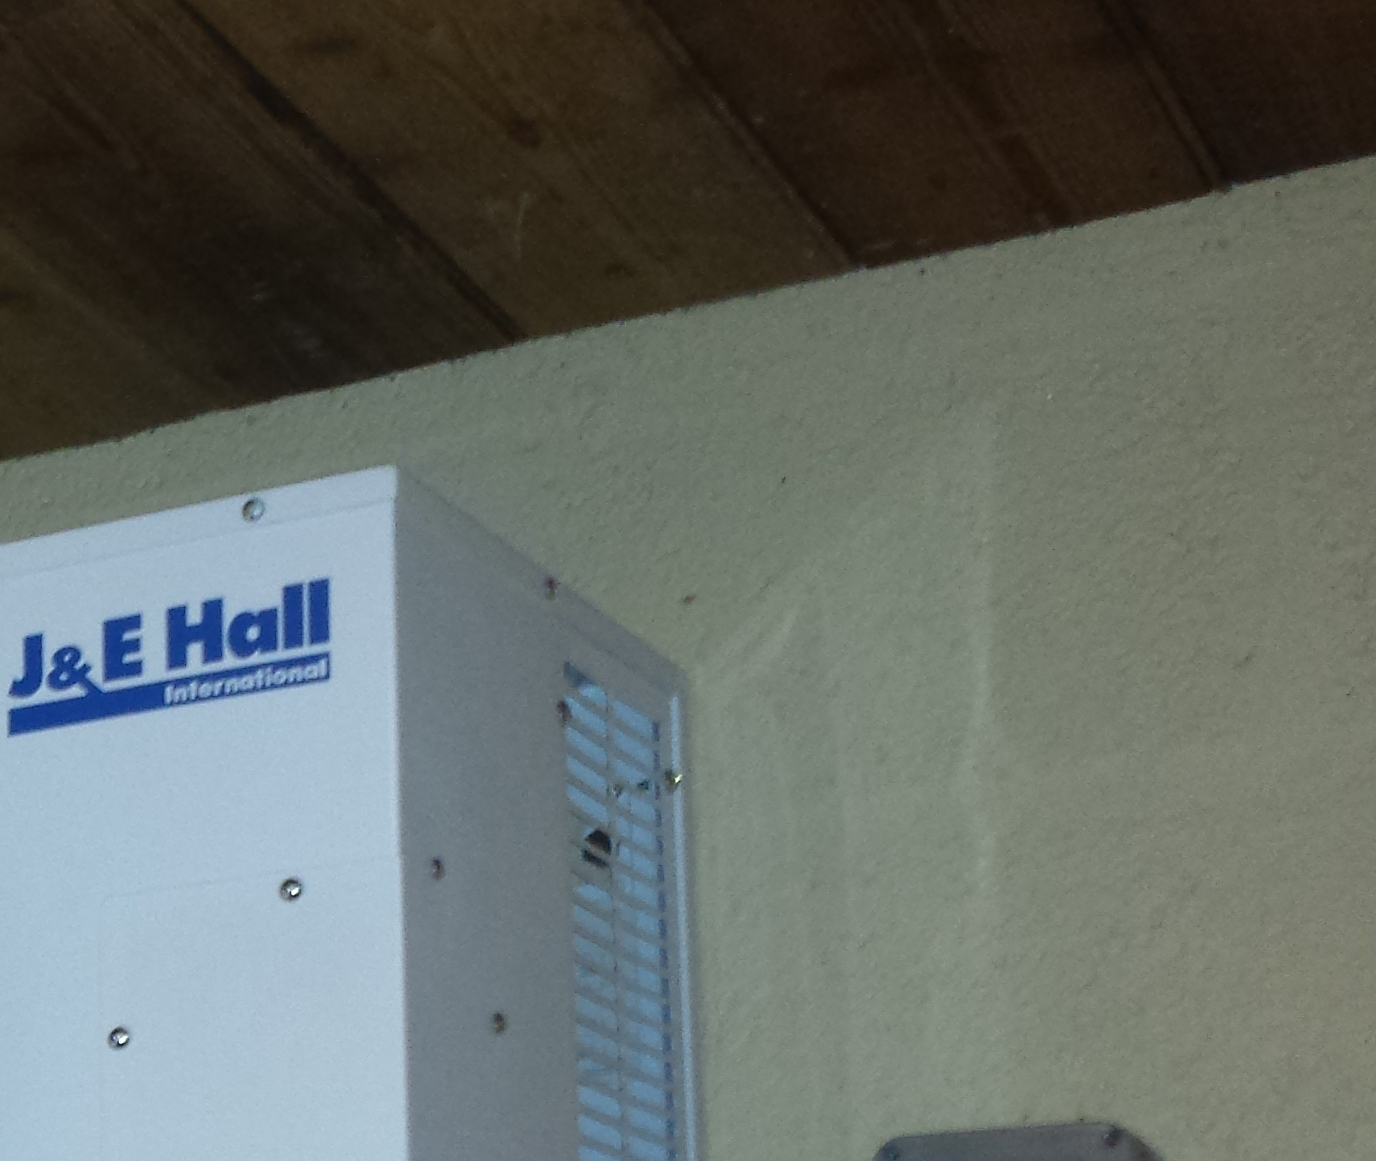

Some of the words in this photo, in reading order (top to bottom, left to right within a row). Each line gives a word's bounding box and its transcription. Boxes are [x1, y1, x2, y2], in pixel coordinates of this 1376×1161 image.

[8, 613, 143, 699] J&E
[166, 576, 331, 671] Hall
[164, 657, 329, 705] International
